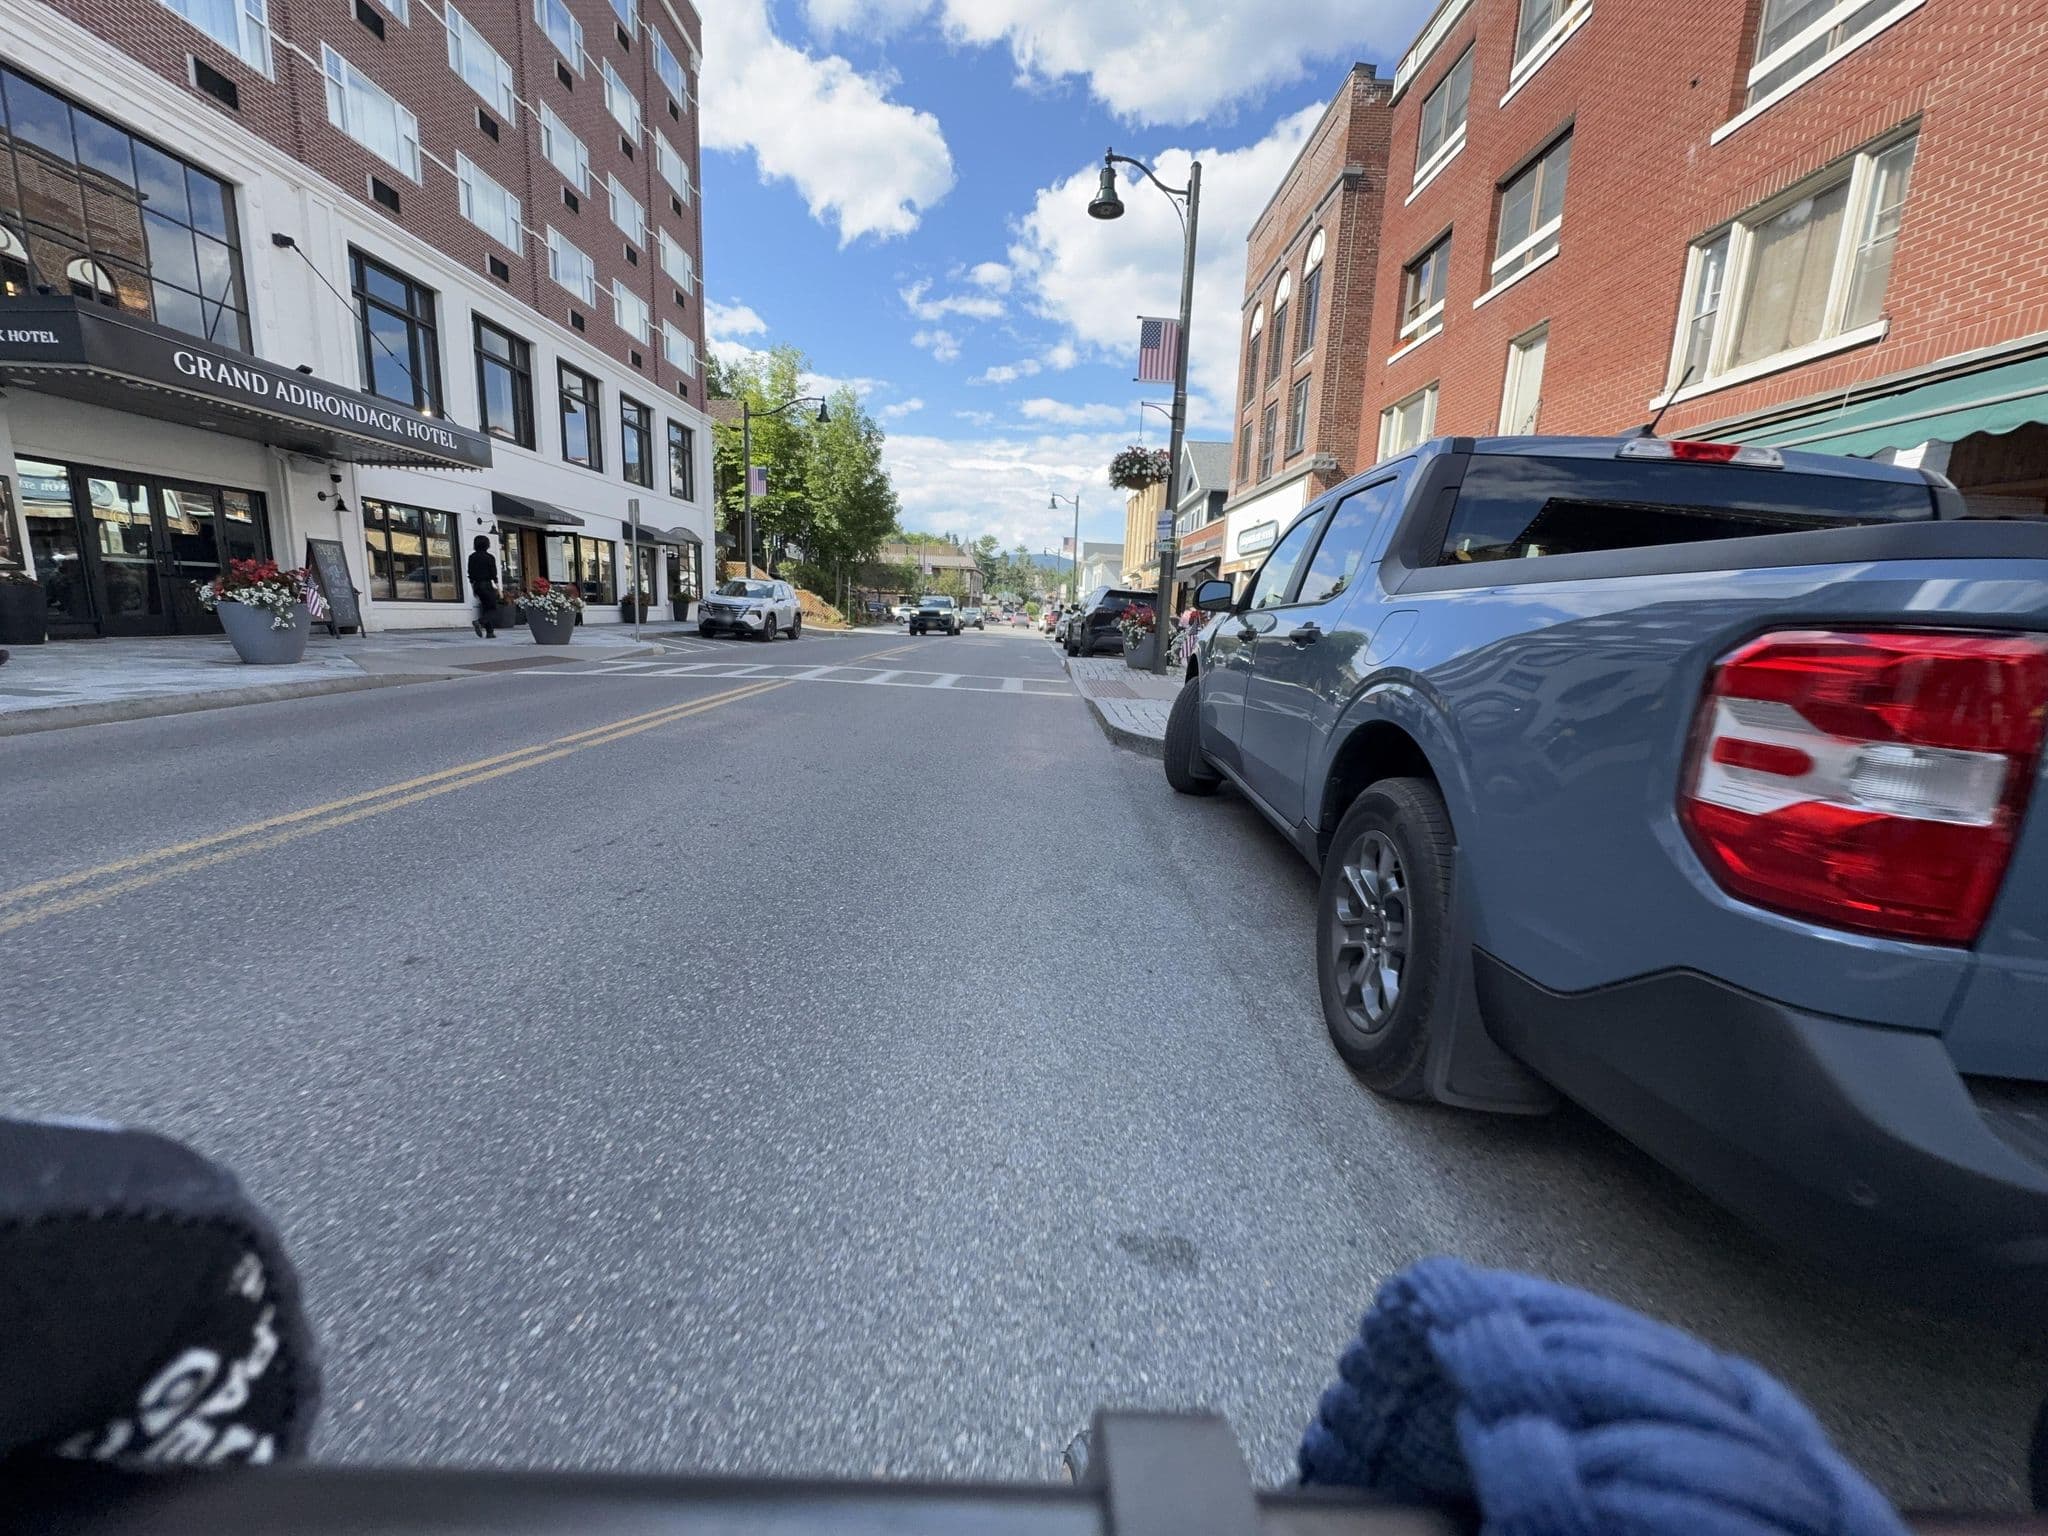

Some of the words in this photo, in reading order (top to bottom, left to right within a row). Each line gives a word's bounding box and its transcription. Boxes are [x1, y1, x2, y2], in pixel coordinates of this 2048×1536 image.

[7, 329, 59, 343] HOTEL
[173, 351, 269, 395] GRAND
[275, 380, 403, 434] ADIRONDACK
[406, 420, 457, 449] HOTEL
